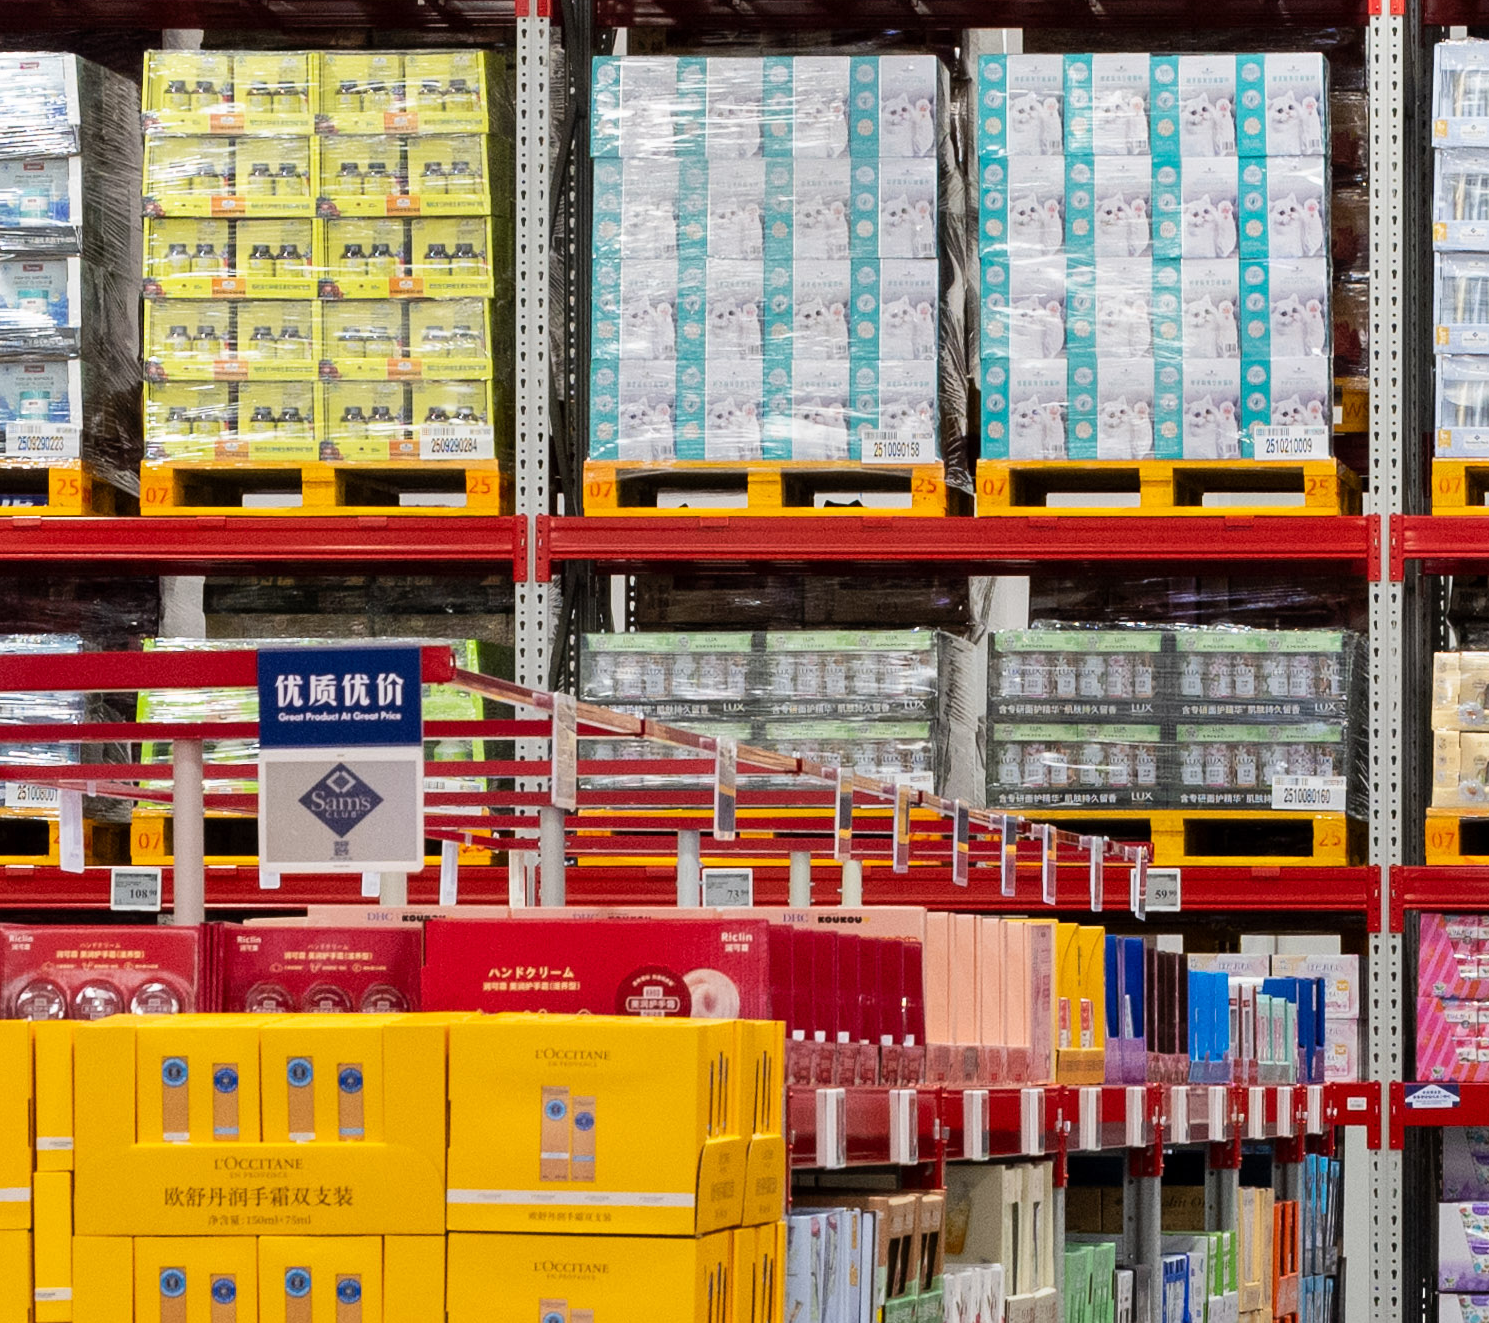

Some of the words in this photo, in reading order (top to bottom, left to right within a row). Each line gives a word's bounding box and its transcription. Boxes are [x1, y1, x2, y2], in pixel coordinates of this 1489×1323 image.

[430, 437, 478, 453] 2509290284
[873, 442, 920, 458] 2510090158
[1266, 438, 1313, 454] 2510210009
[145, 486, 167, 505] 07
[275, 673, 405, 707] 优质优价
[278, 713, 303, 721] Great
[341, 712, 351, 720] At
[353, 712, 378, 720] Great
[381, 711, 401, 719] Price
[1064, 704, 1116, 714] 肌肤持久留香
[1131, 703, 1153, 713] LUX
[311, 791, 371, 811] Sam's
[1283, 786, 1331, 804] 2510080160
[721, 931, 753, 942] Riclin
[488, 966, 575, 979] ハンドクリーム
[535, 1048, 611, 1062] L'OCCITANE
[214, 1156, 303, 1171] L'OCCITANE
[164, 1186, 353, 1208] 欧舒丹润手霜双支装
